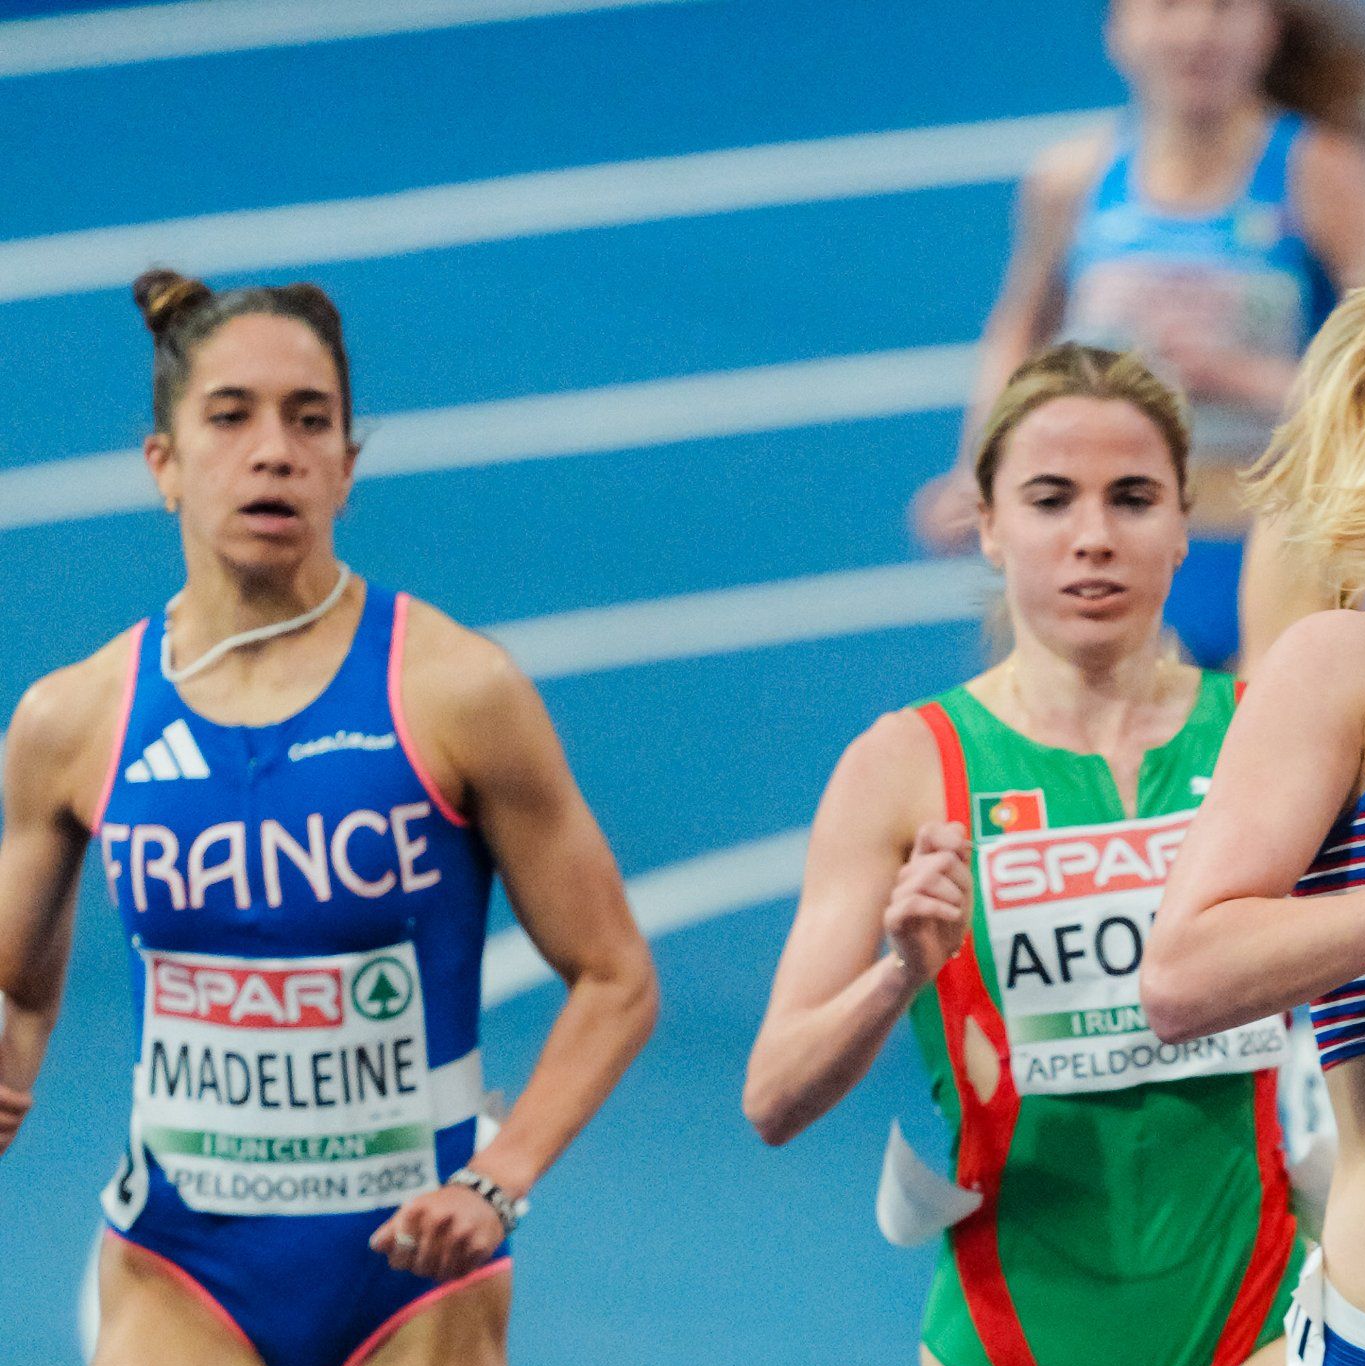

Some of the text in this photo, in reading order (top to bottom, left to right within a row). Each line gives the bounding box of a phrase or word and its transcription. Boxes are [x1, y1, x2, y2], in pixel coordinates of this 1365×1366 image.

[101, 801, 441, 913] FRANCE
[1006, 911, 1157, 990] AFO
[156, 960, 341, 1025] SPAR
[150, 1036, 417, 1110] MADELEINE
[1026, 1036, 1229, 1083] APELDOORN
